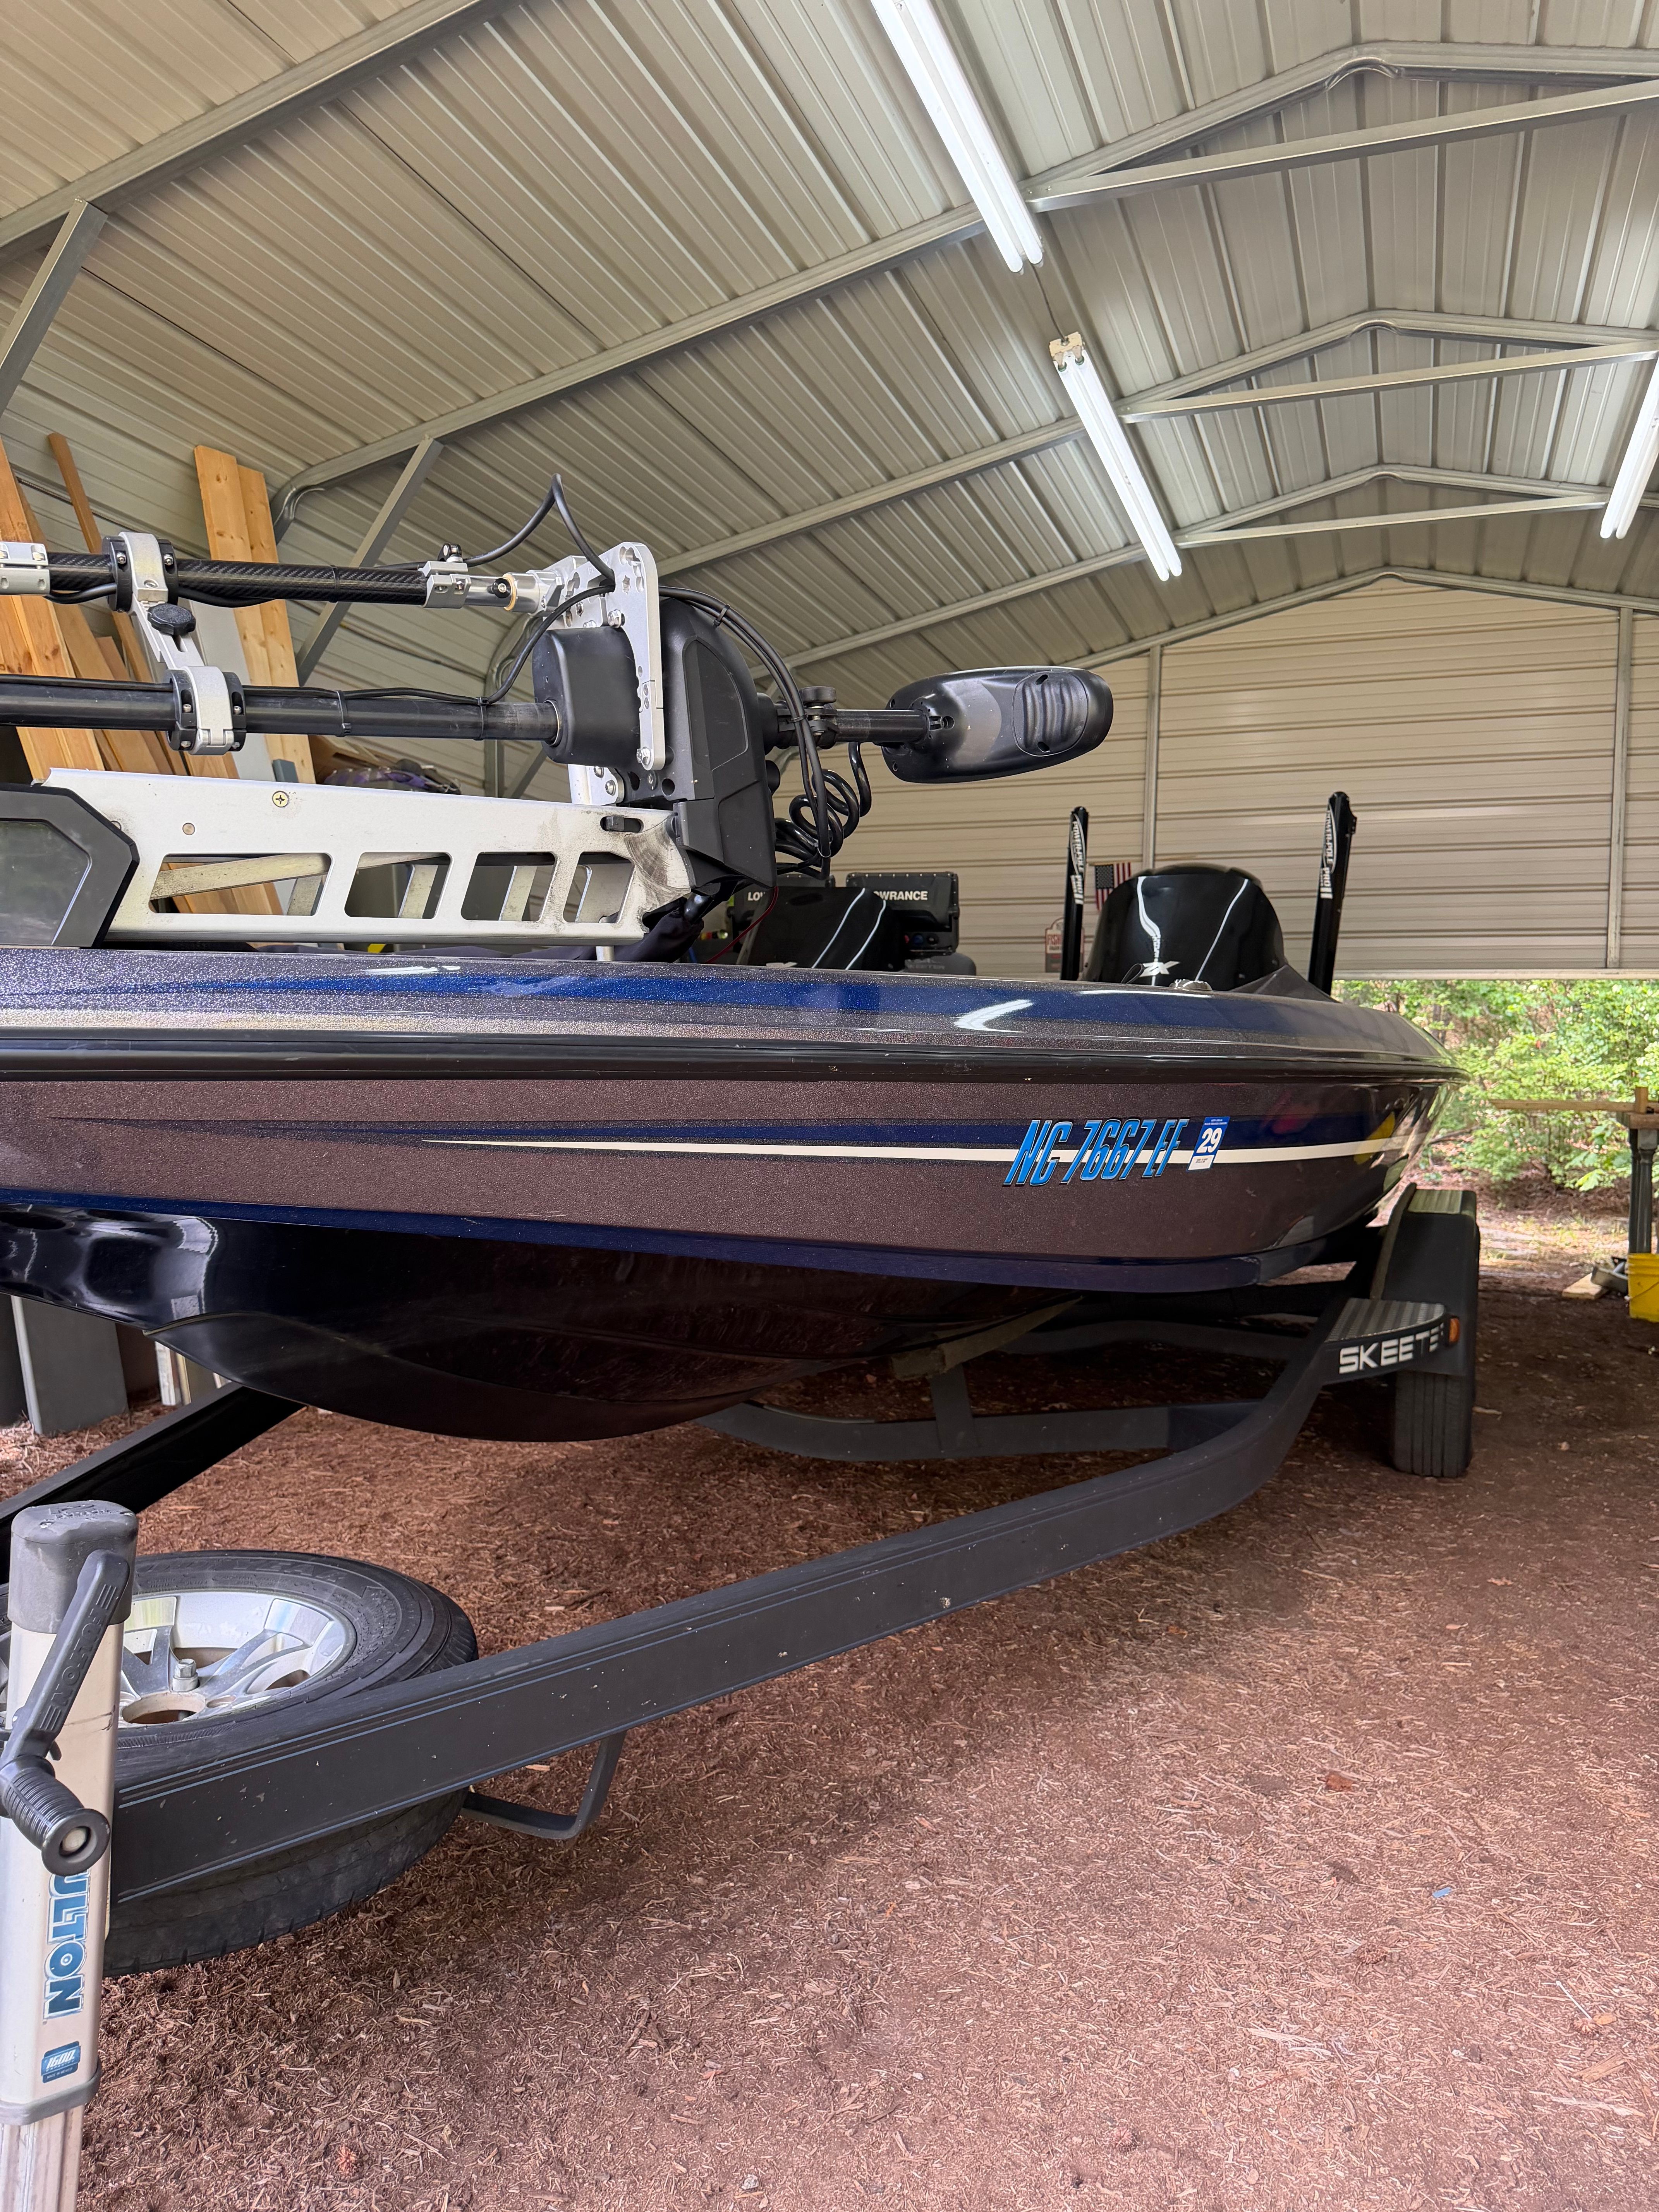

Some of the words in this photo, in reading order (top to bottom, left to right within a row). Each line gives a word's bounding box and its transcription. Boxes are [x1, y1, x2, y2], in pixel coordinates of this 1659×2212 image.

[873, 891, 928, 900] WRANCE
[1003, 1120, 1073, 1186] NC
[1060, 1118, 1158, 1184] 7667
[1196, 1127, 1222, 1153] 29
[43, 1870, 90, 2020] ULTON
